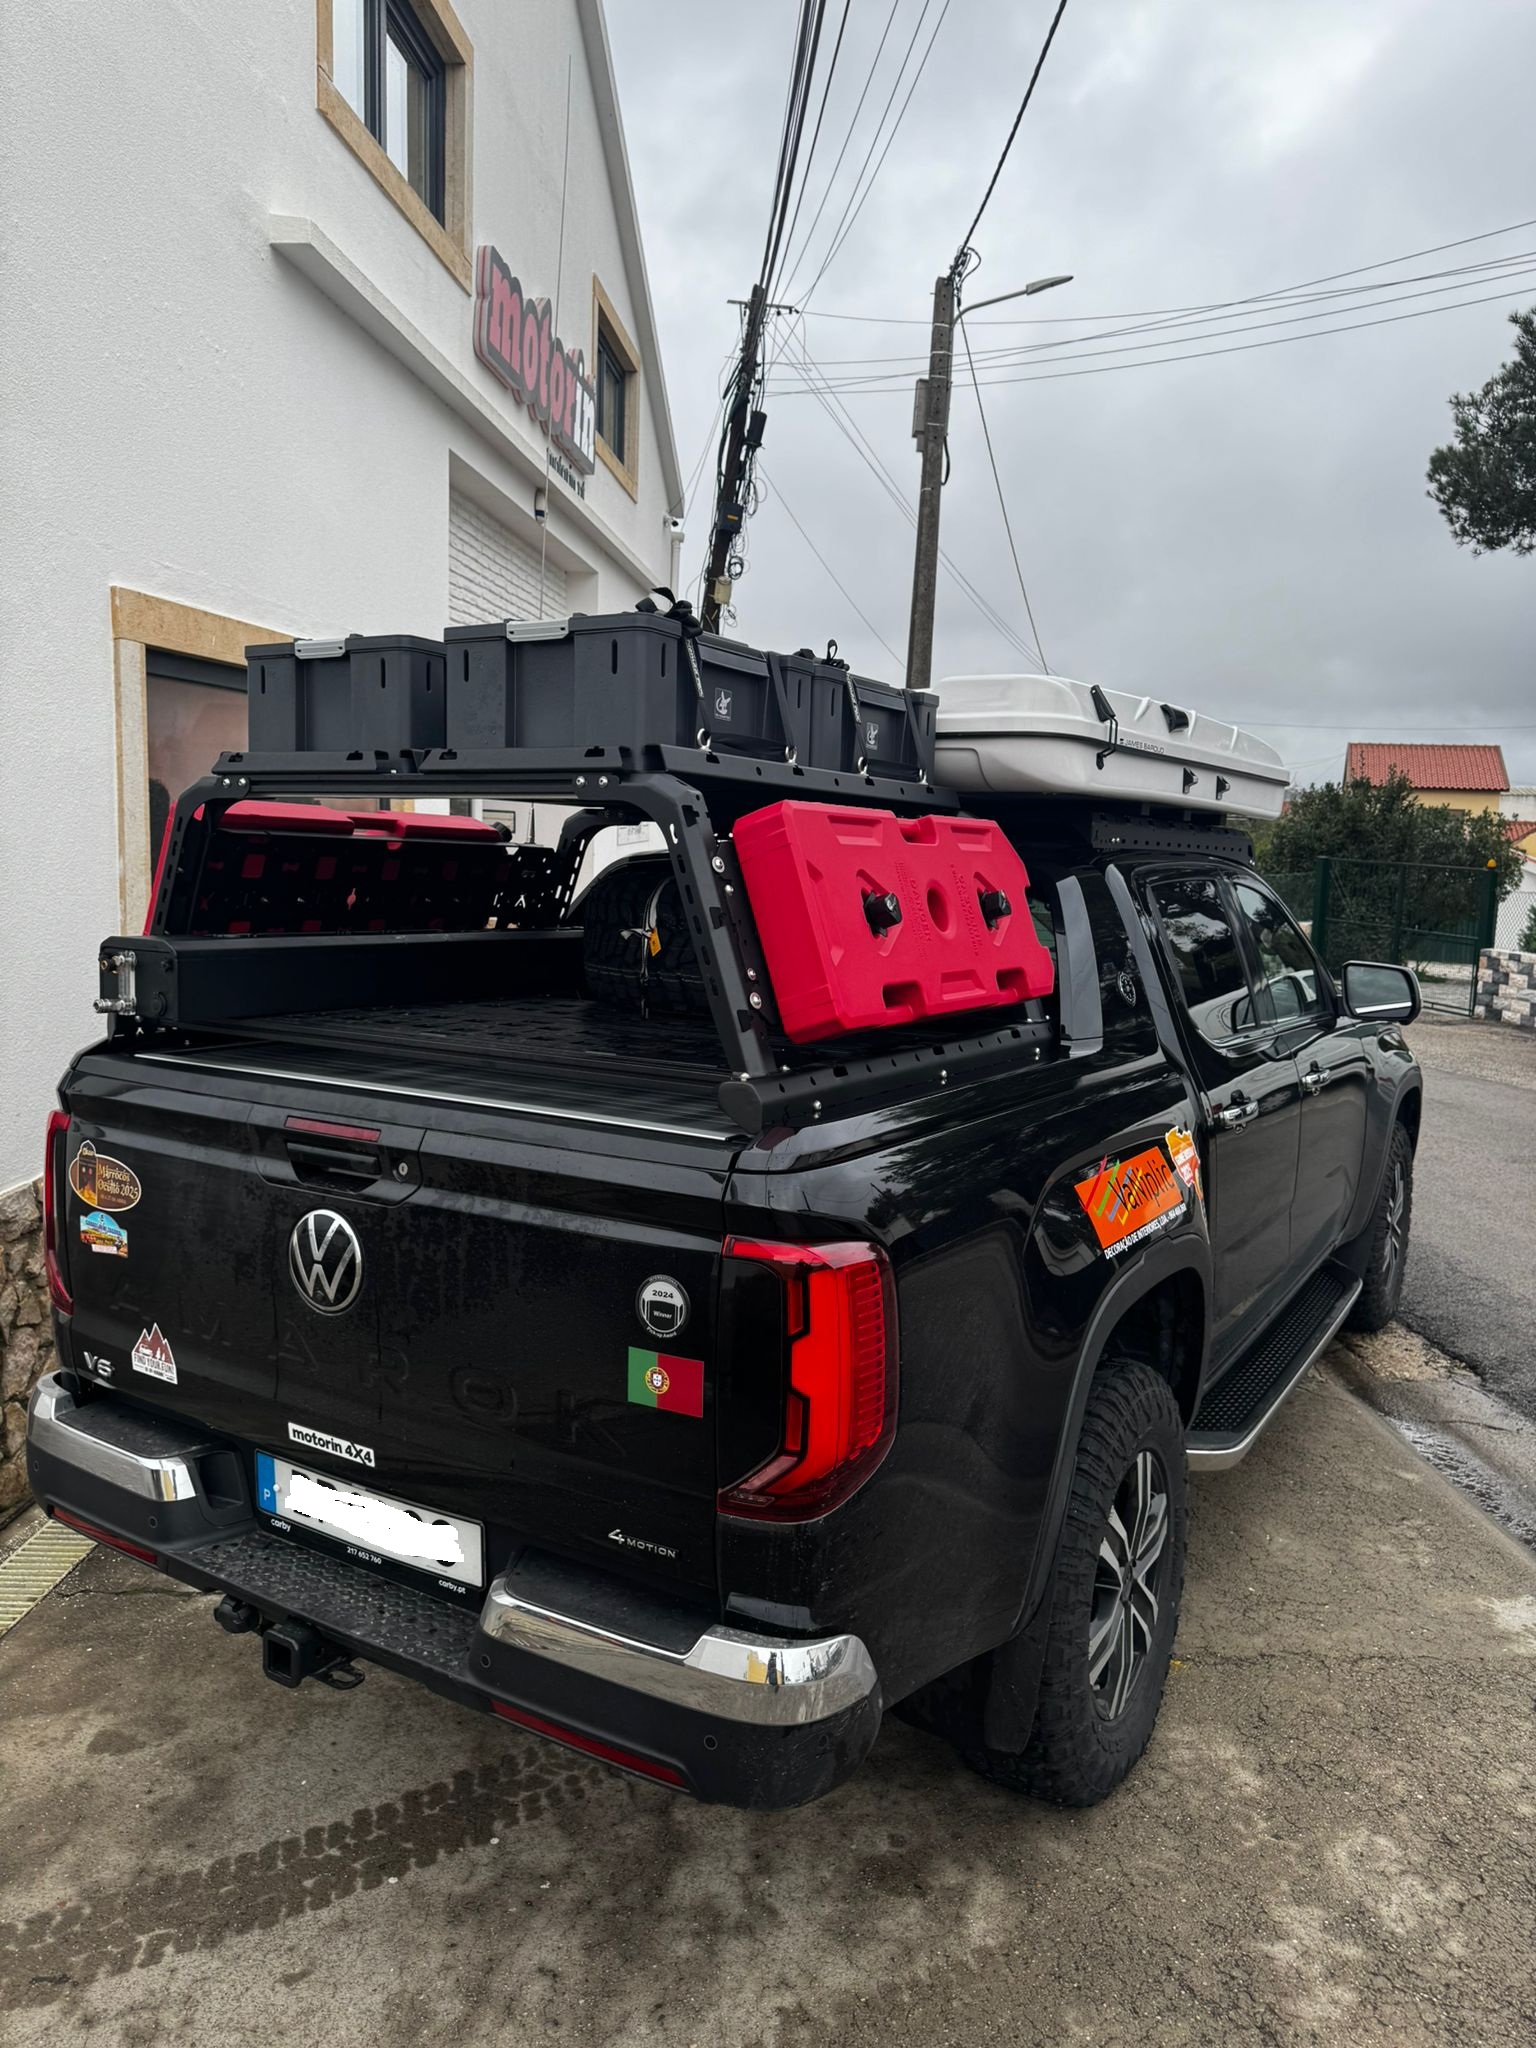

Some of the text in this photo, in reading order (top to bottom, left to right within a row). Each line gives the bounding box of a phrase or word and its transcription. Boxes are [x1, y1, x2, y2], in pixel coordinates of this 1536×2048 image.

[489, 262, 595, 468] motorin
[652, 1289, 674, 1299] 2024
[653, 1310, 672, 1319] Winner
[83, 1351, 114, 1377] V6
[292, 1428, 343, 1454] motorin
[263, 1488, 271, 1501] P
[271, 1519, 291, 1532] carby
[346, 1546, 382, 1565] 217 652 760
[438, 1579, 466, 1595] carby.pt
